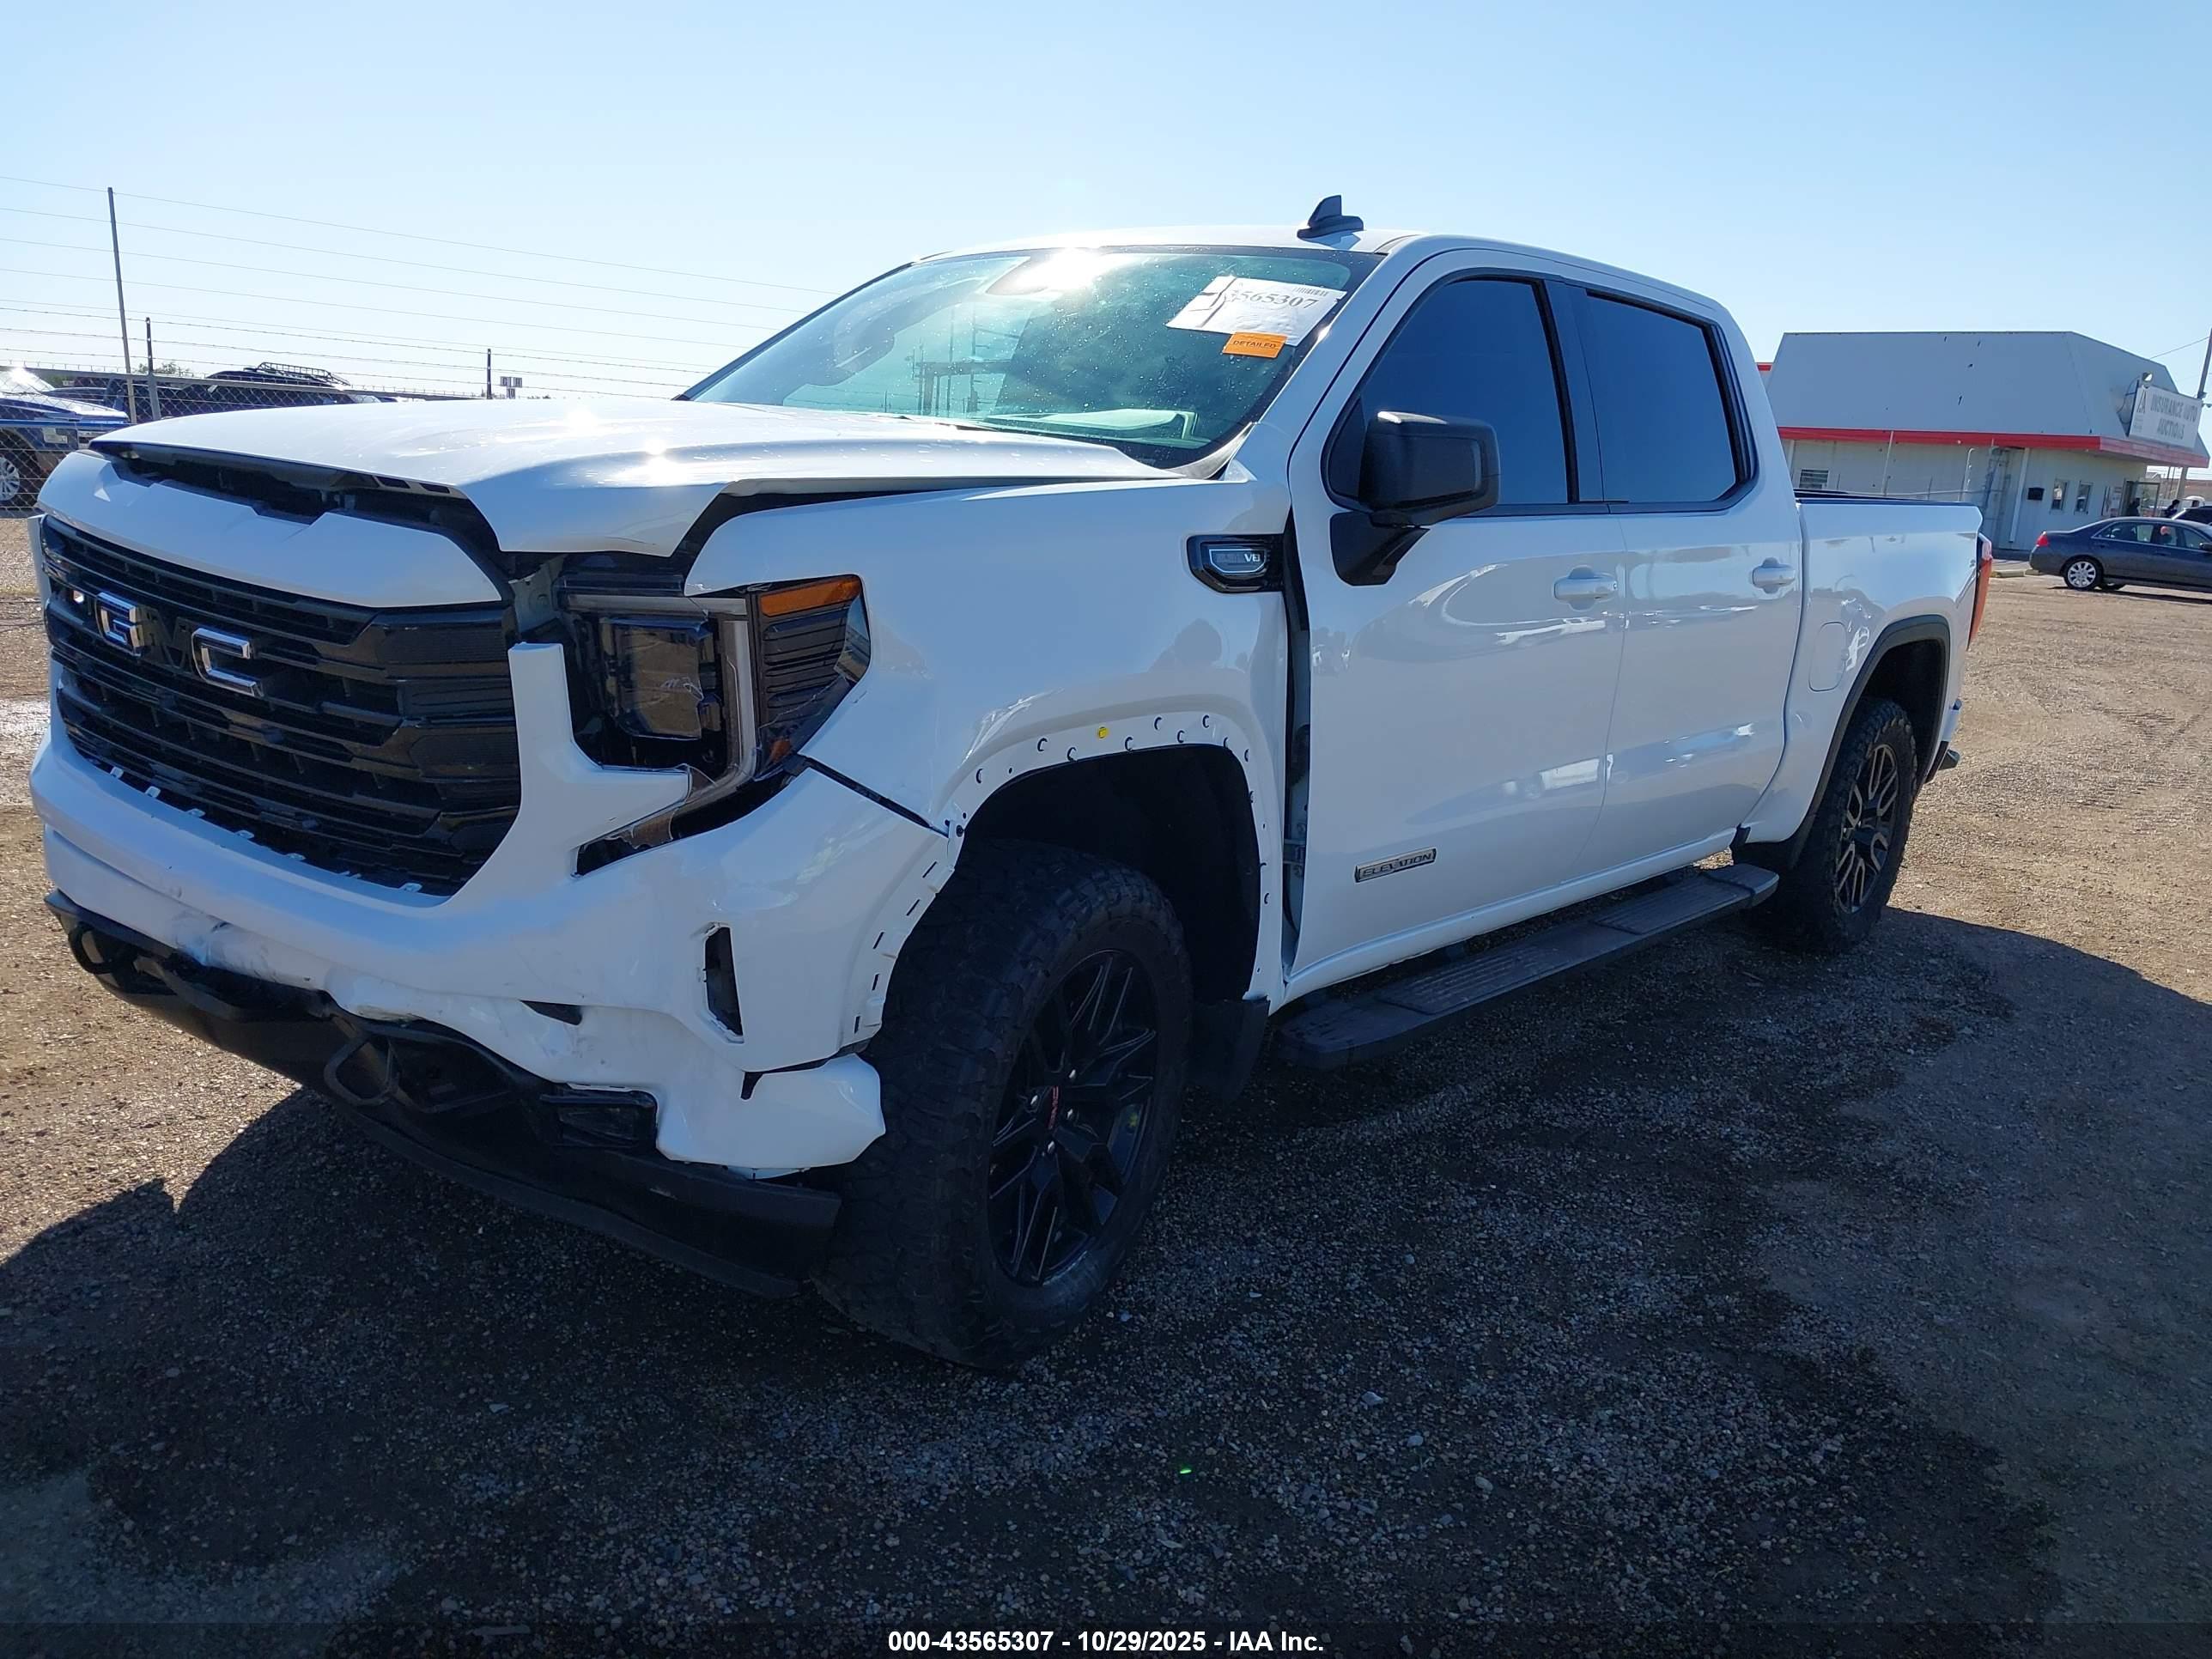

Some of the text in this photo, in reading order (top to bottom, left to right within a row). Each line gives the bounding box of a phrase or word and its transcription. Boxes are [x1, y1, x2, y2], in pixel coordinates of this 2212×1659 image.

[1233, 339, 1276, 349] DETAILED
[2150, 393, 2184, 418] INSURANCE
[1244, 553, 1261, 562] V8
[1361, 852, 1432, 877] ELEVATION
